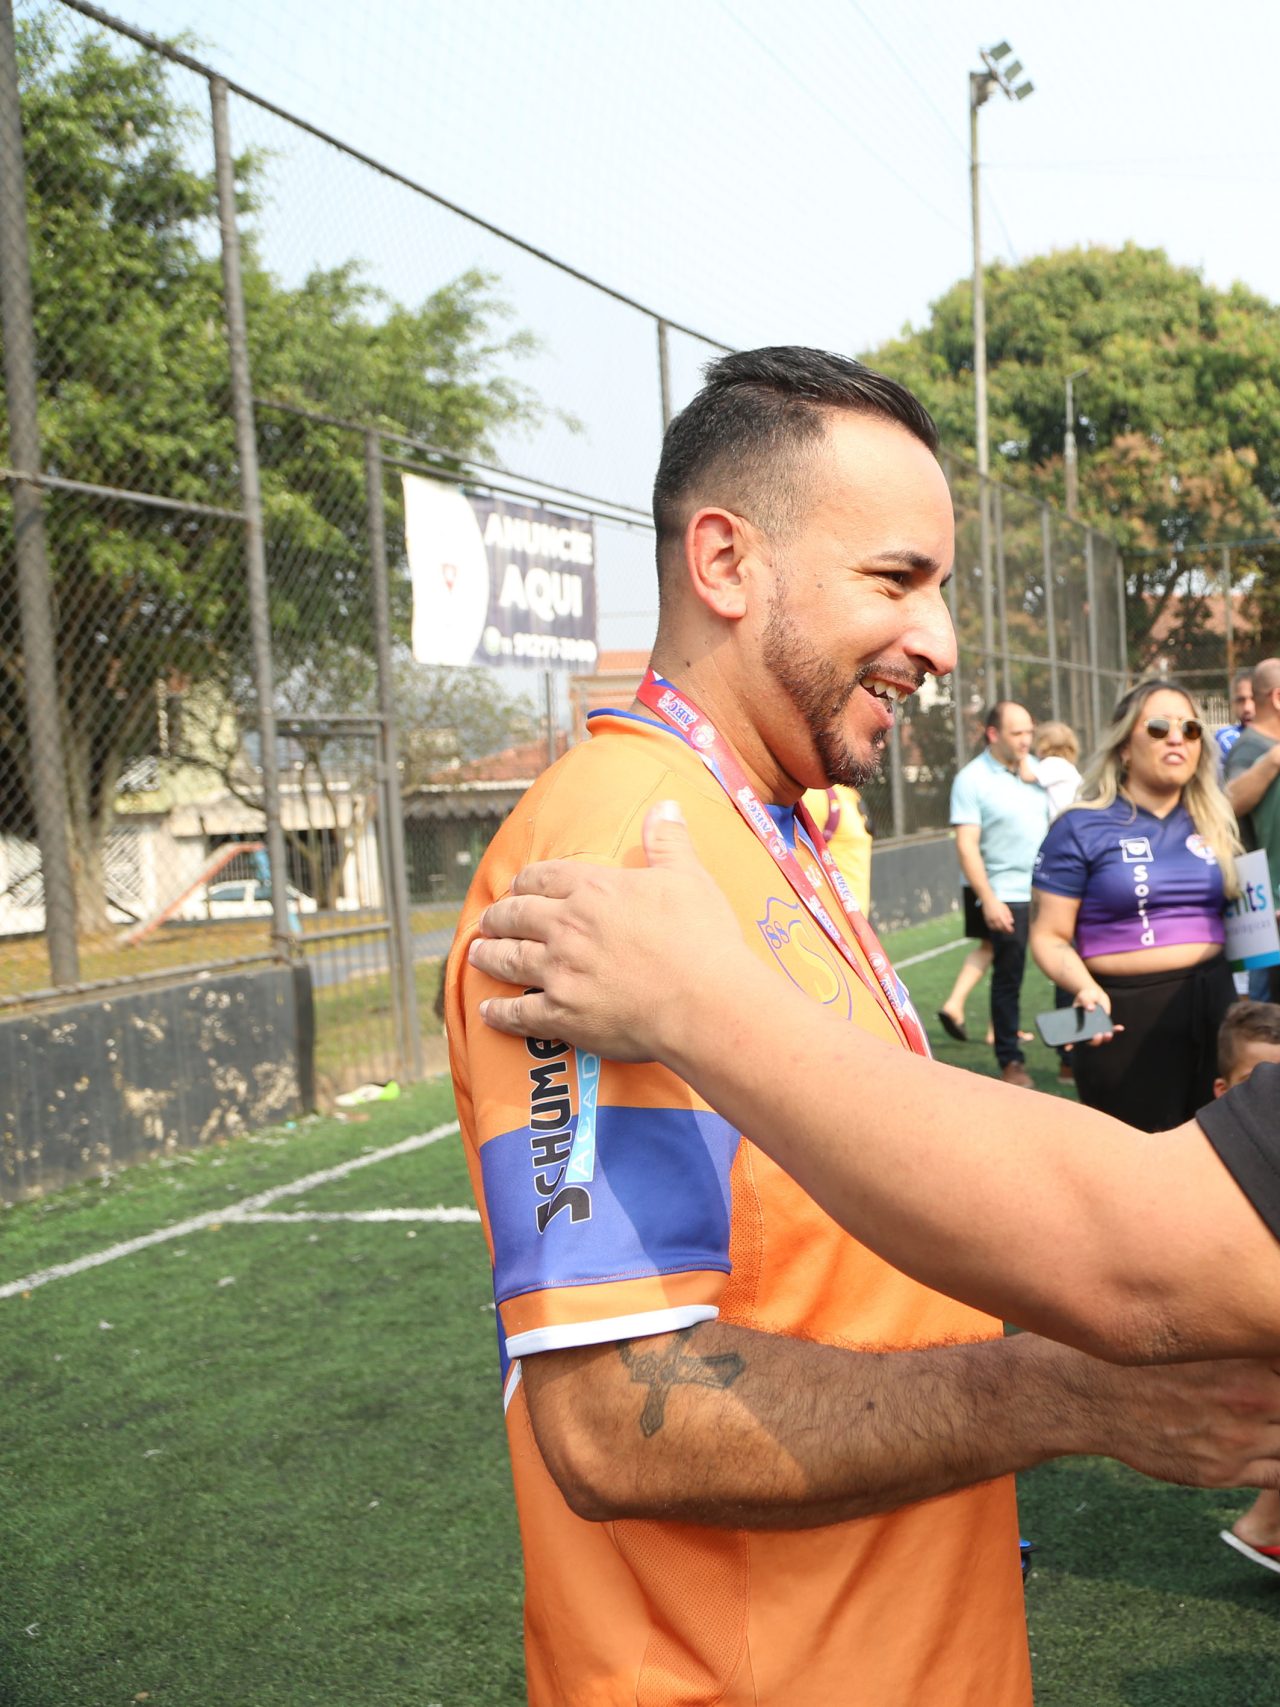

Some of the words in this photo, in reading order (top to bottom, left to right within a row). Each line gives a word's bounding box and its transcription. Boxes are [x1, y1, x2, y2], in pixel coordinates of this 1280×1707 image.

[484, 513, 593, 565] ANUNCIE
[499, 564, 583, 622] AQUI
[1225, 881, 1268, 918] nts
[765, 920, 790, 949] 88
[524, 986, 592, 1234] SCHUMA
